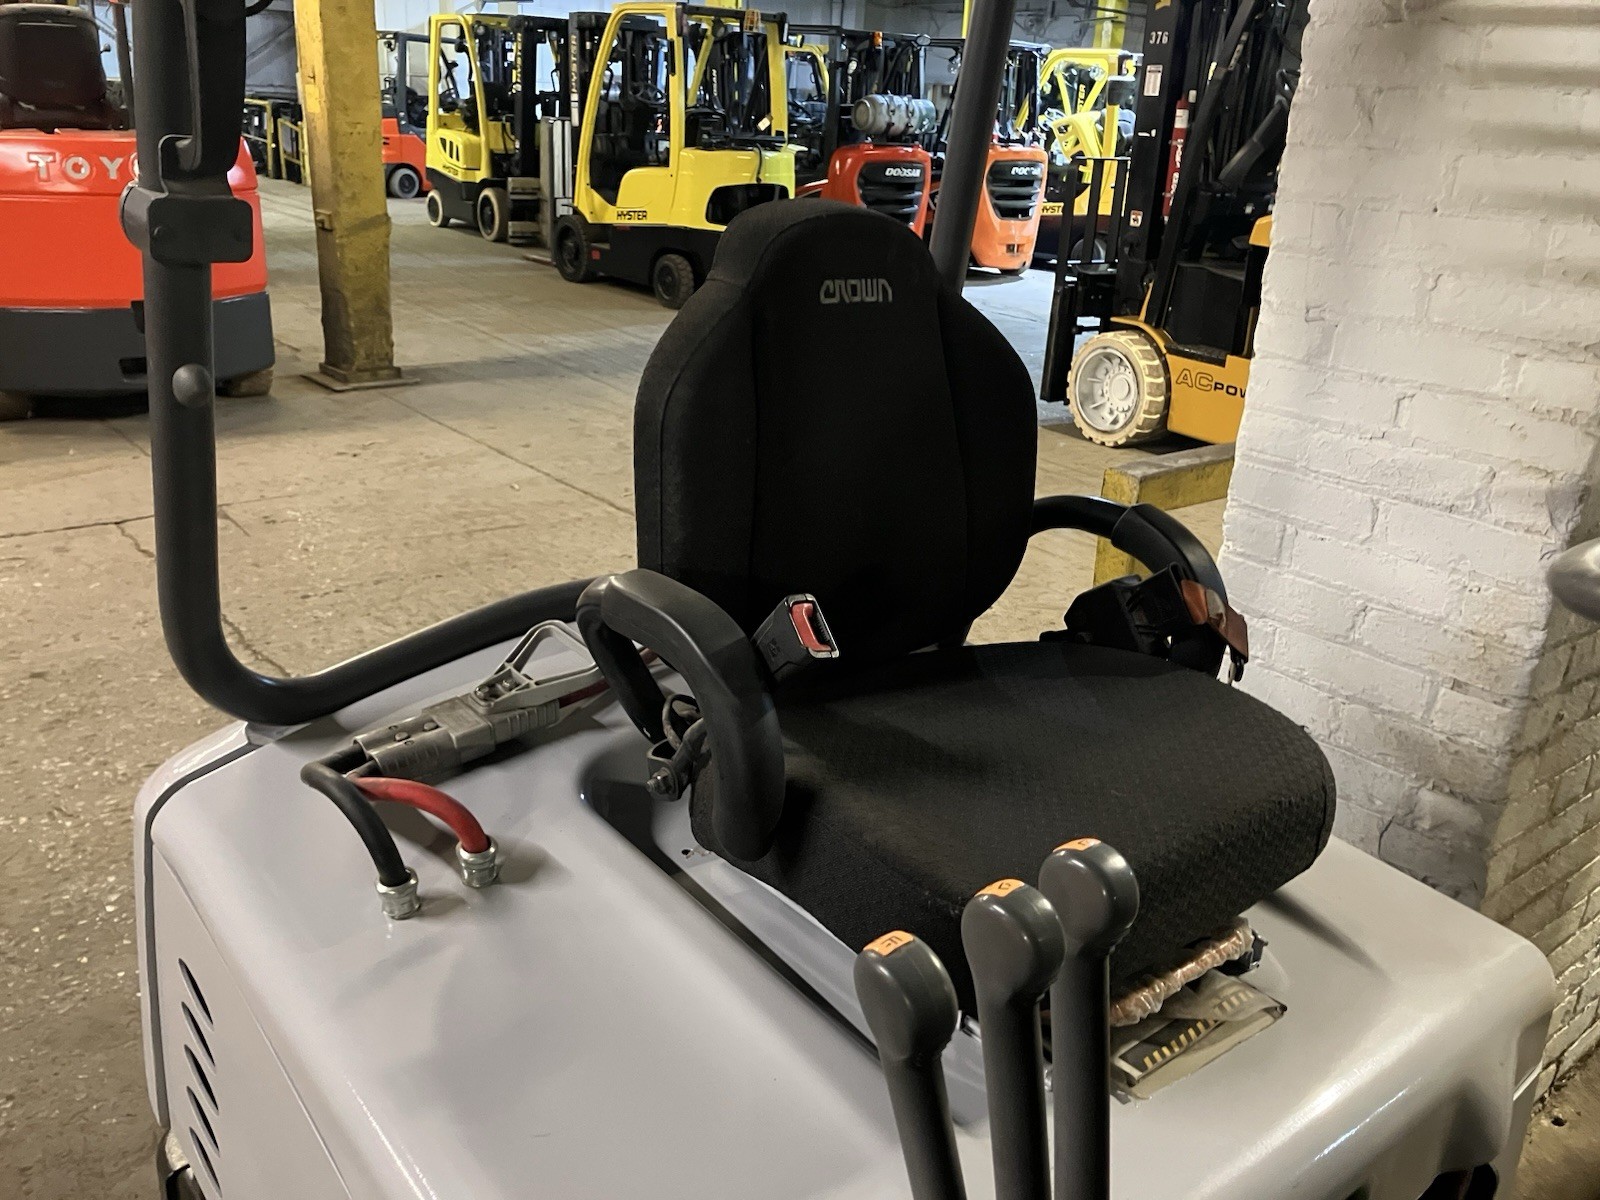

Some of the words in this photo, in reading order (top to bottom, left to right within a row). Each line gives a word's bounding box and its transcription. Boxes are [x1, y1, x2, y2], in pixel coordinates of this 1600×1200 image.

[1149, 31, 1169, 44] 376
[27, 152, 138, 182] TOY
[616, 210, 647, 220] HYSTER
[820, 279, 893, 304] CROWN
